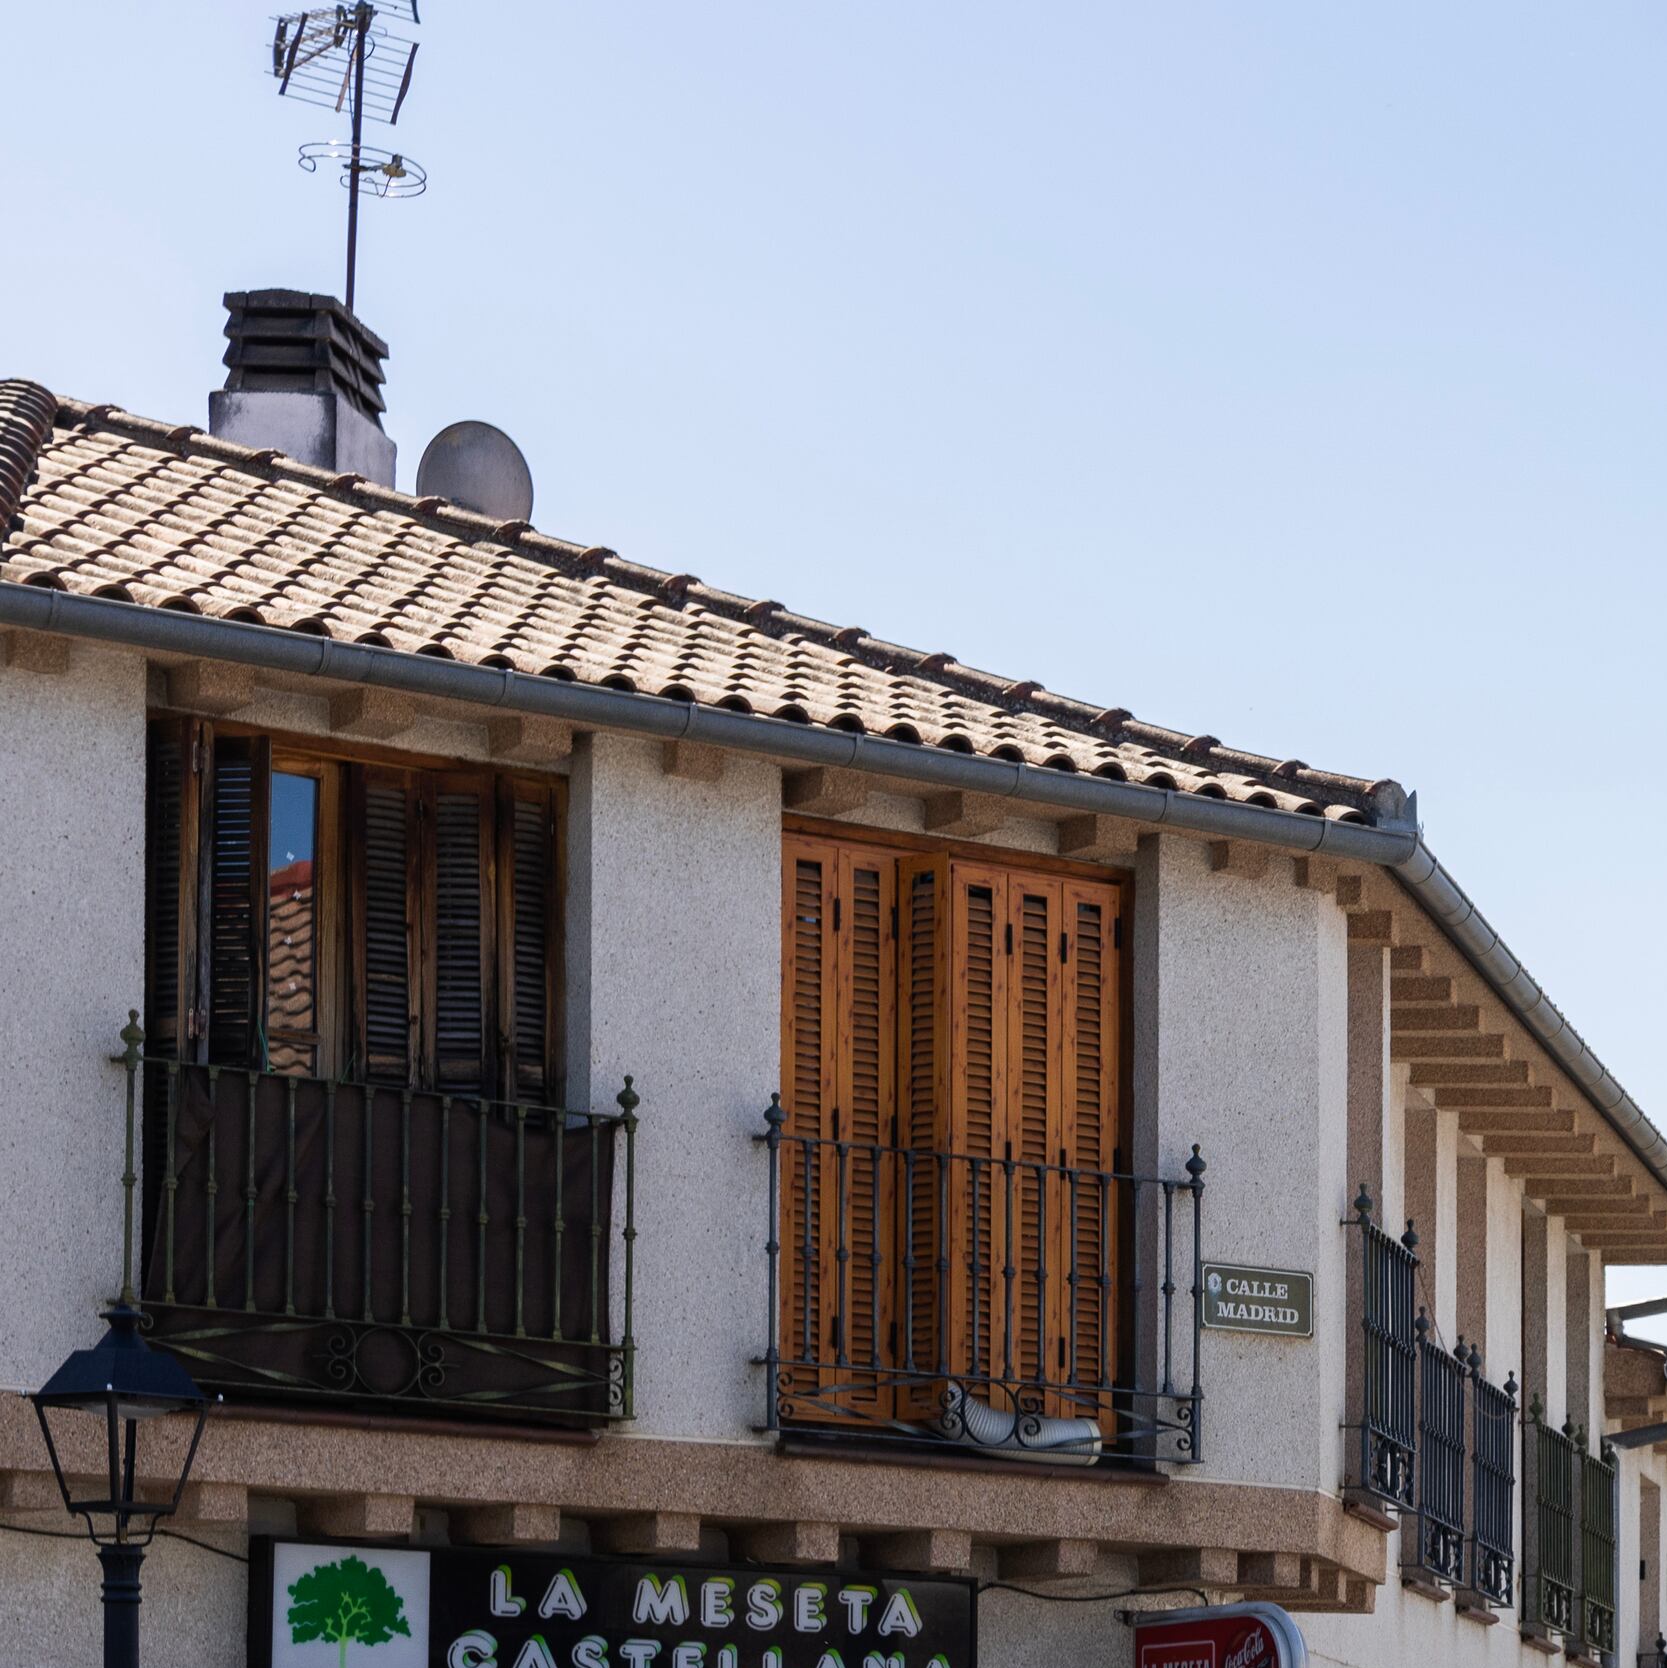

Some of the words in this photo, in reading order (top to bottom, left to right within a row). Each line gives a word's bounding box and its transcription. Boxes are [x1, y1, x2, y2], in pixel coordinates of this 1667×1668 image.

[1226, 1279, 1288, 1299] CALLE
[1217, 1302, 1299, 1324] MADRID
[490, 1565, 588, 1620] LA
[632, 1573, 923, 1639] MESETA
